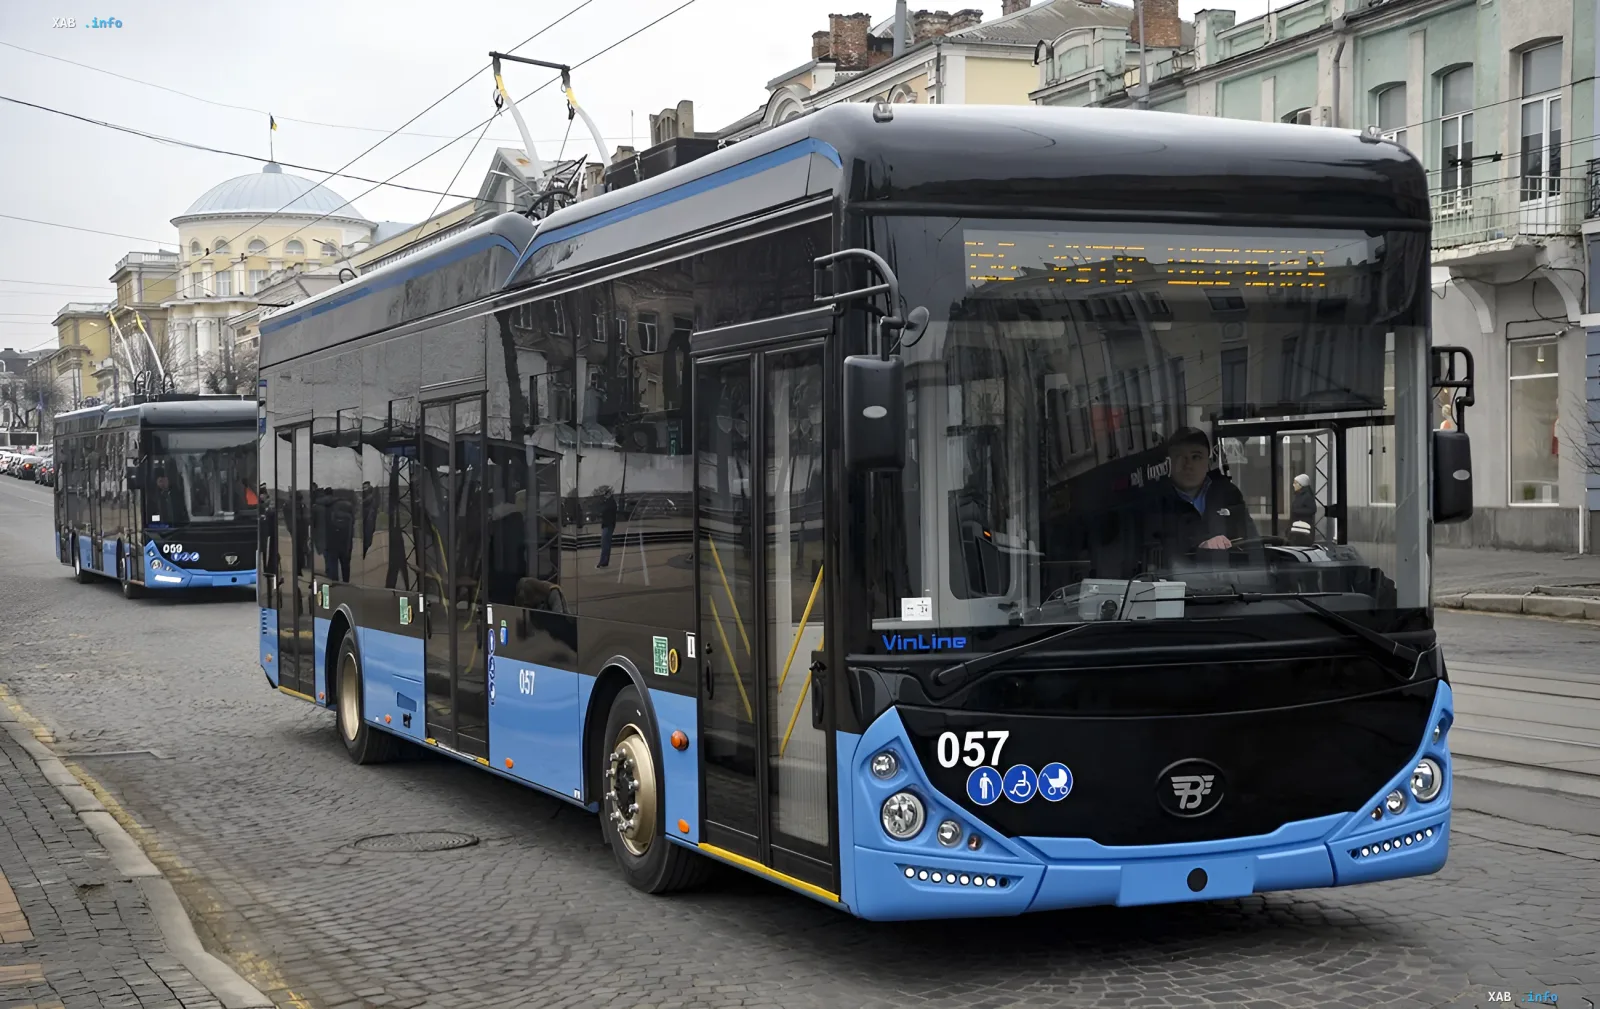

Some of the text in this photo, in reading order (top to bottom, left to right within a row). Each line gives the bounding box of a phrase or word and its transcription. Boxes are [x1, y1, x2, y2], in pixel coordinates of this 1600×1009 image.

[882, 635, 967, 650] VinLine
[519, 669, 536, 695] 057
[937, 730, 1010, 768] 057
